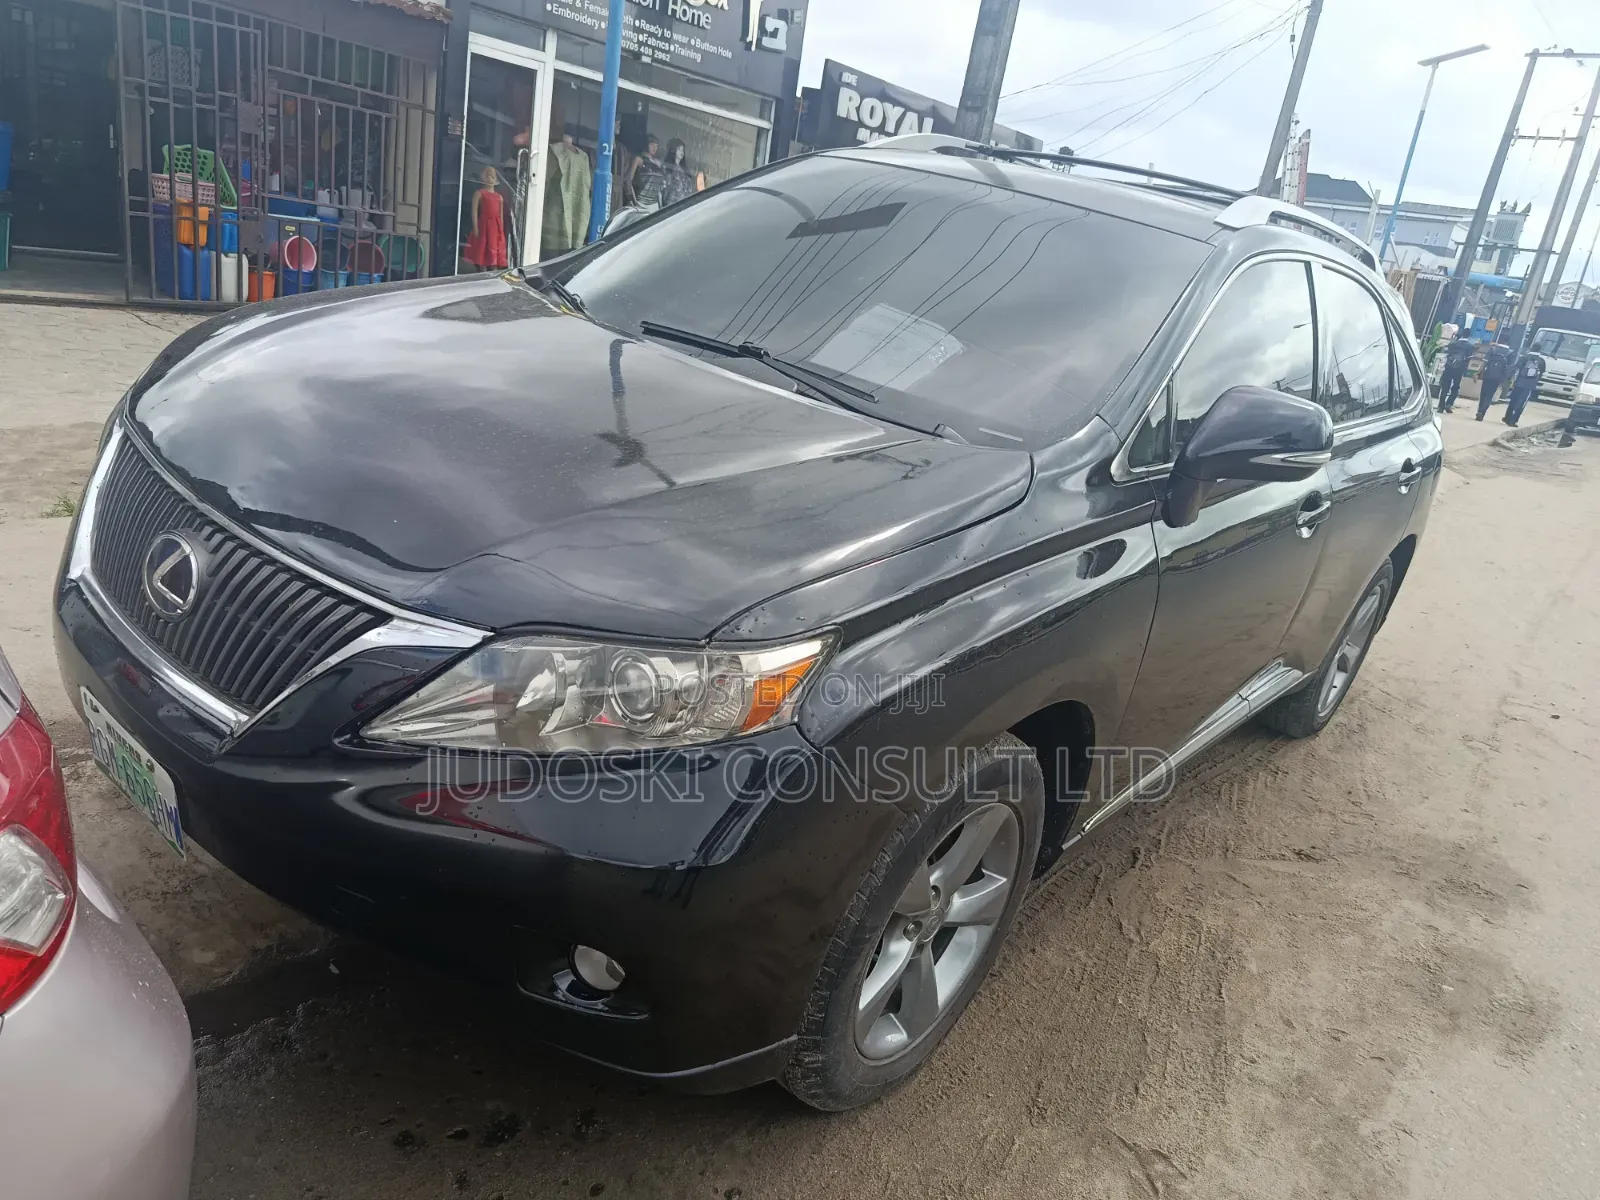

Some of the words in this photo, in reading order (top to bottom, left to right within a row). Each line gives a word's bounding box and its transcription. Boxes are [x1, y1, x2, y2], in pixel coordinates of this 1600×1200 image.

[552, 3, 600, 29] Embroidery
[643, 34, 669, 51] Fabrics
[674, 44, 702, 63] Training
[584, 1, 609, 17] Femal
[640, 19, 663, 38] Ready
[664, 28, 671, 38] to
[672, 32, 689, 43] wear
[695, 38, 718, 54] Button
[718, 46, 732, 59] Hole
[667, 0, 712, 29] Home
[105, 720, 143, 765] RIVERS
